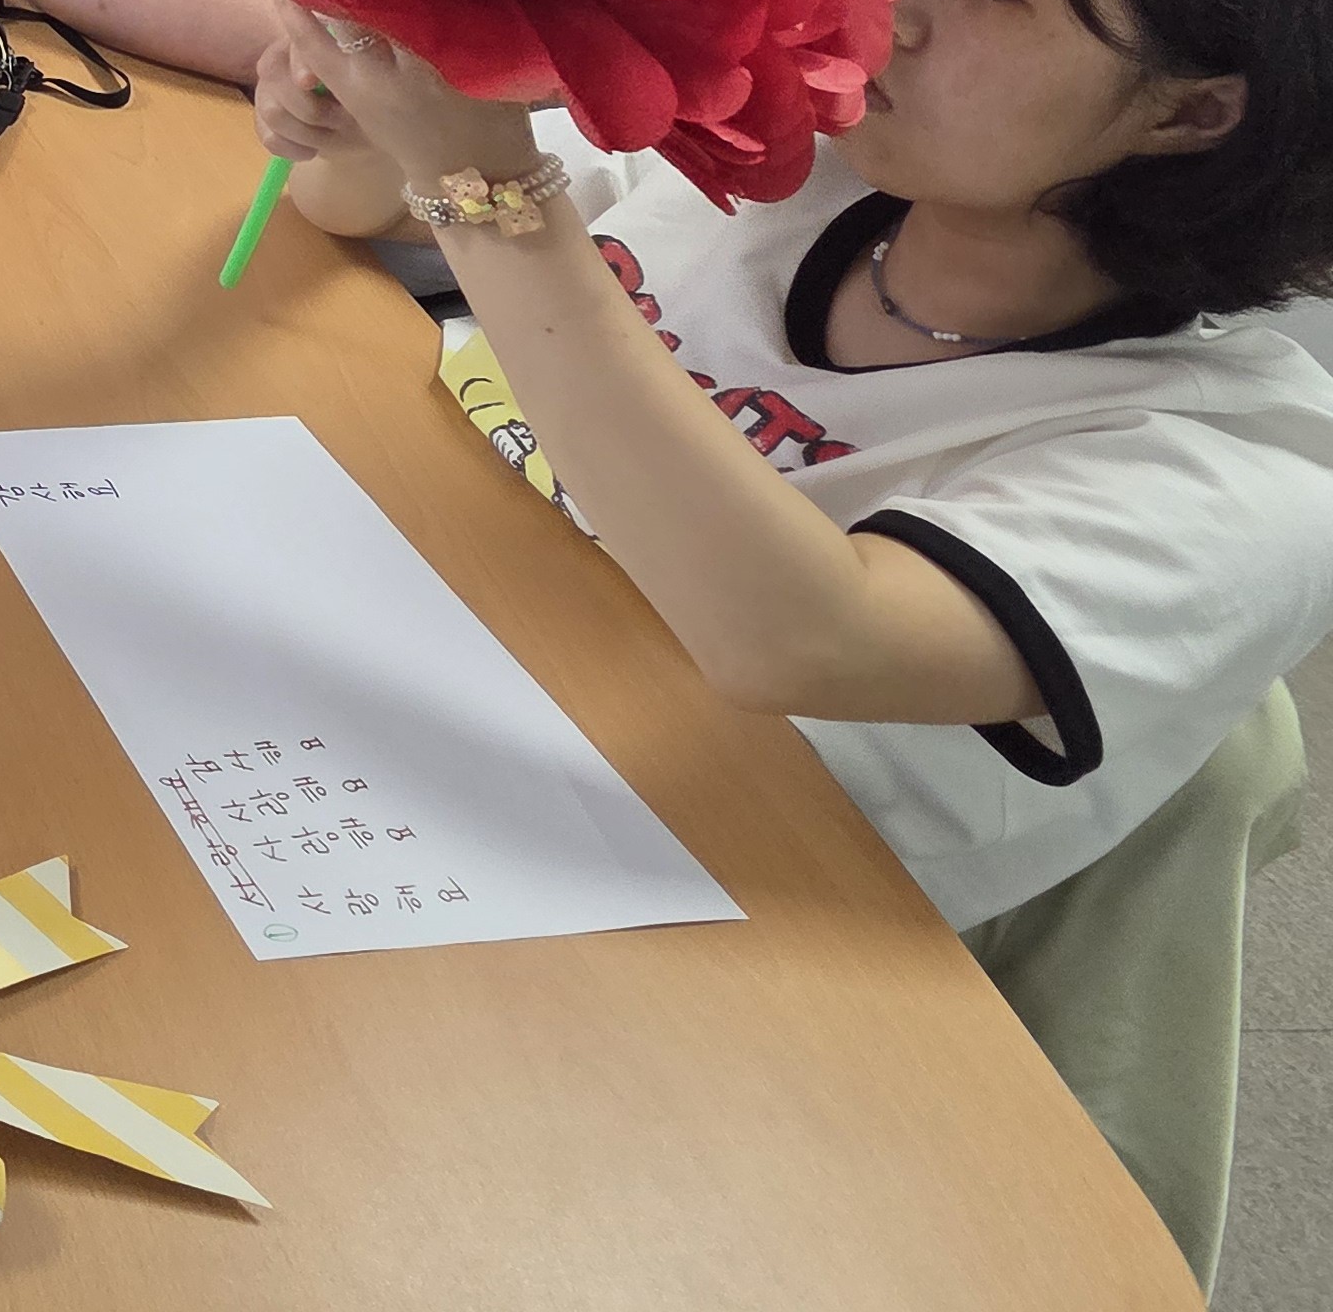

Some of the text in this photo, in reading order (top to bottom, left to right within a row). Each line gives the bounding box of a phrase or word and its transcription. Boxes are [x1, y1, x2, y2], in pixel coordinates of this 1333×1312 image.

[185, 736, 324, 784] 감사해요
[221, 775, 368, 823] 사랑해요
[253, 817, 417, 862] 사랑해요
[297, 877, 469, 917] 사랑해요
